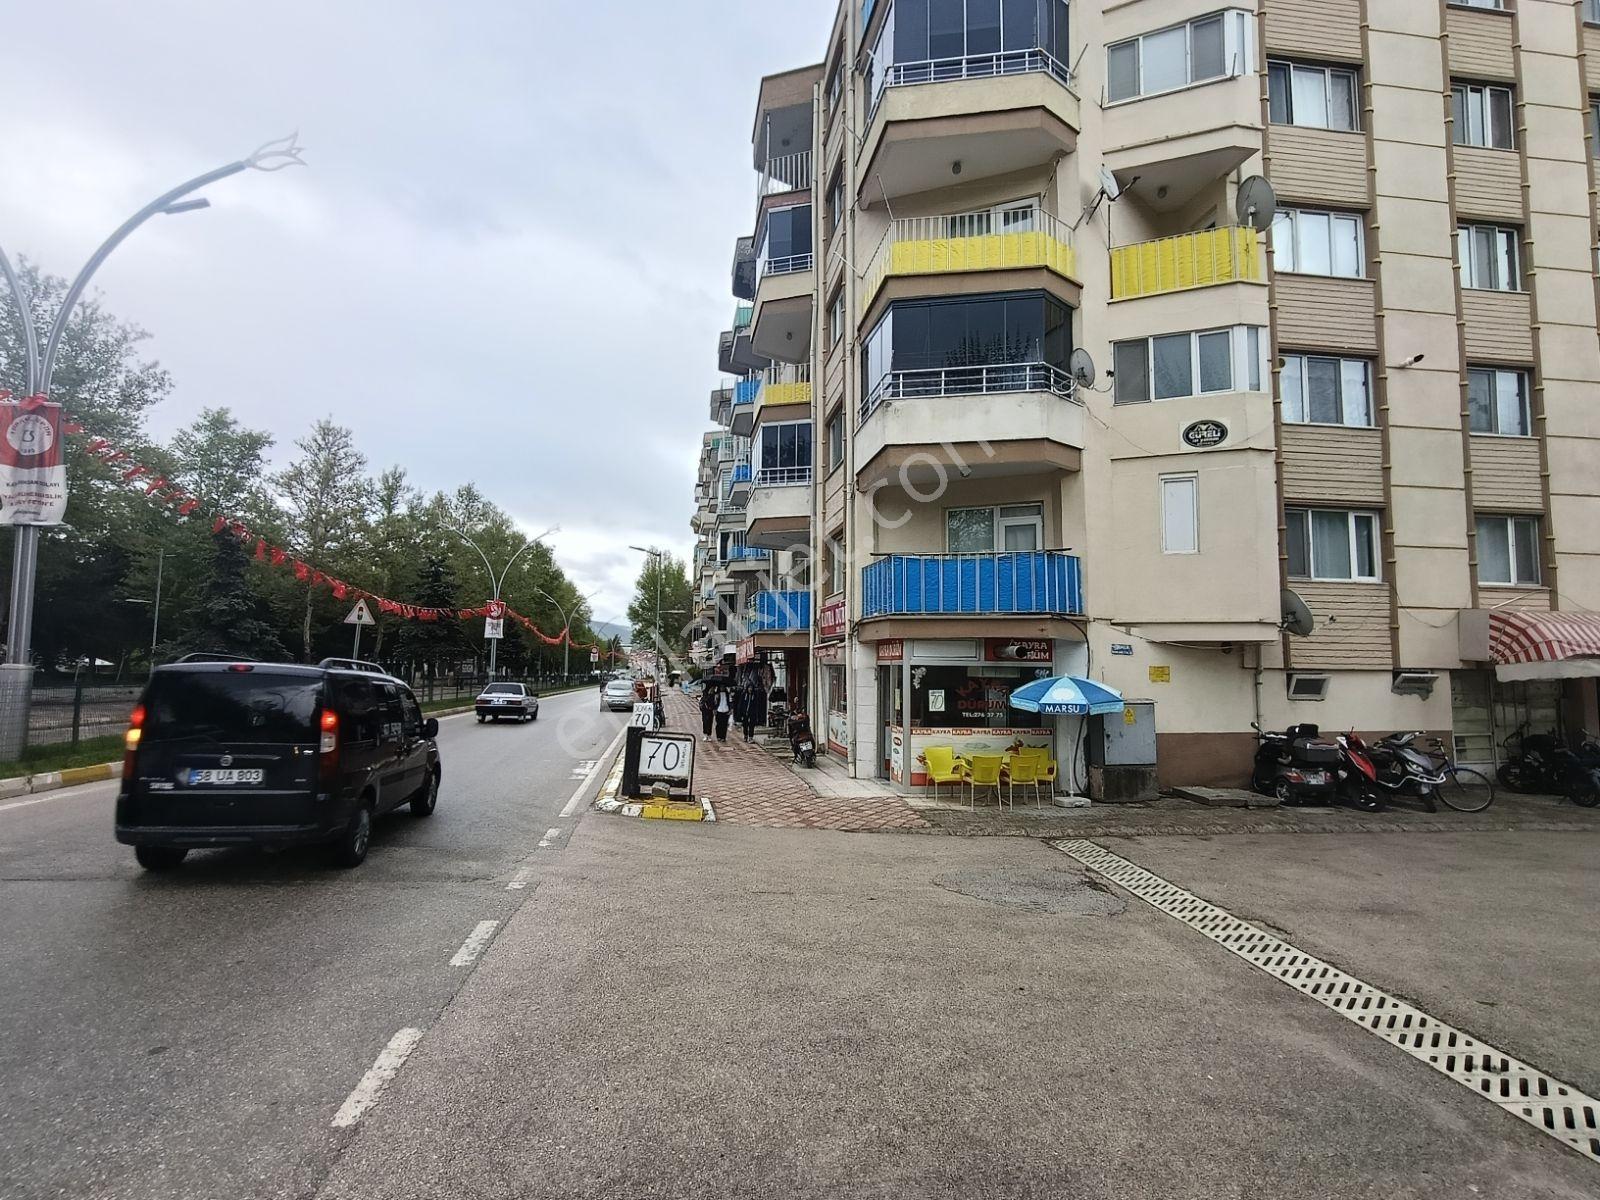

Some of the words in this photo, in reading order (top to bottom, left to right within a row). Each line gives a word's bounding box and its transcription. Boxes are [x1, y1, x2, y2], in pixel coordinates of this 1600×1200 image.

[1045, 704, 1080, 713] MARSU
[635, 713, 651, 726] 70
[647, 740, 680, 771] 70
[238, 770, 260, 781] 803
